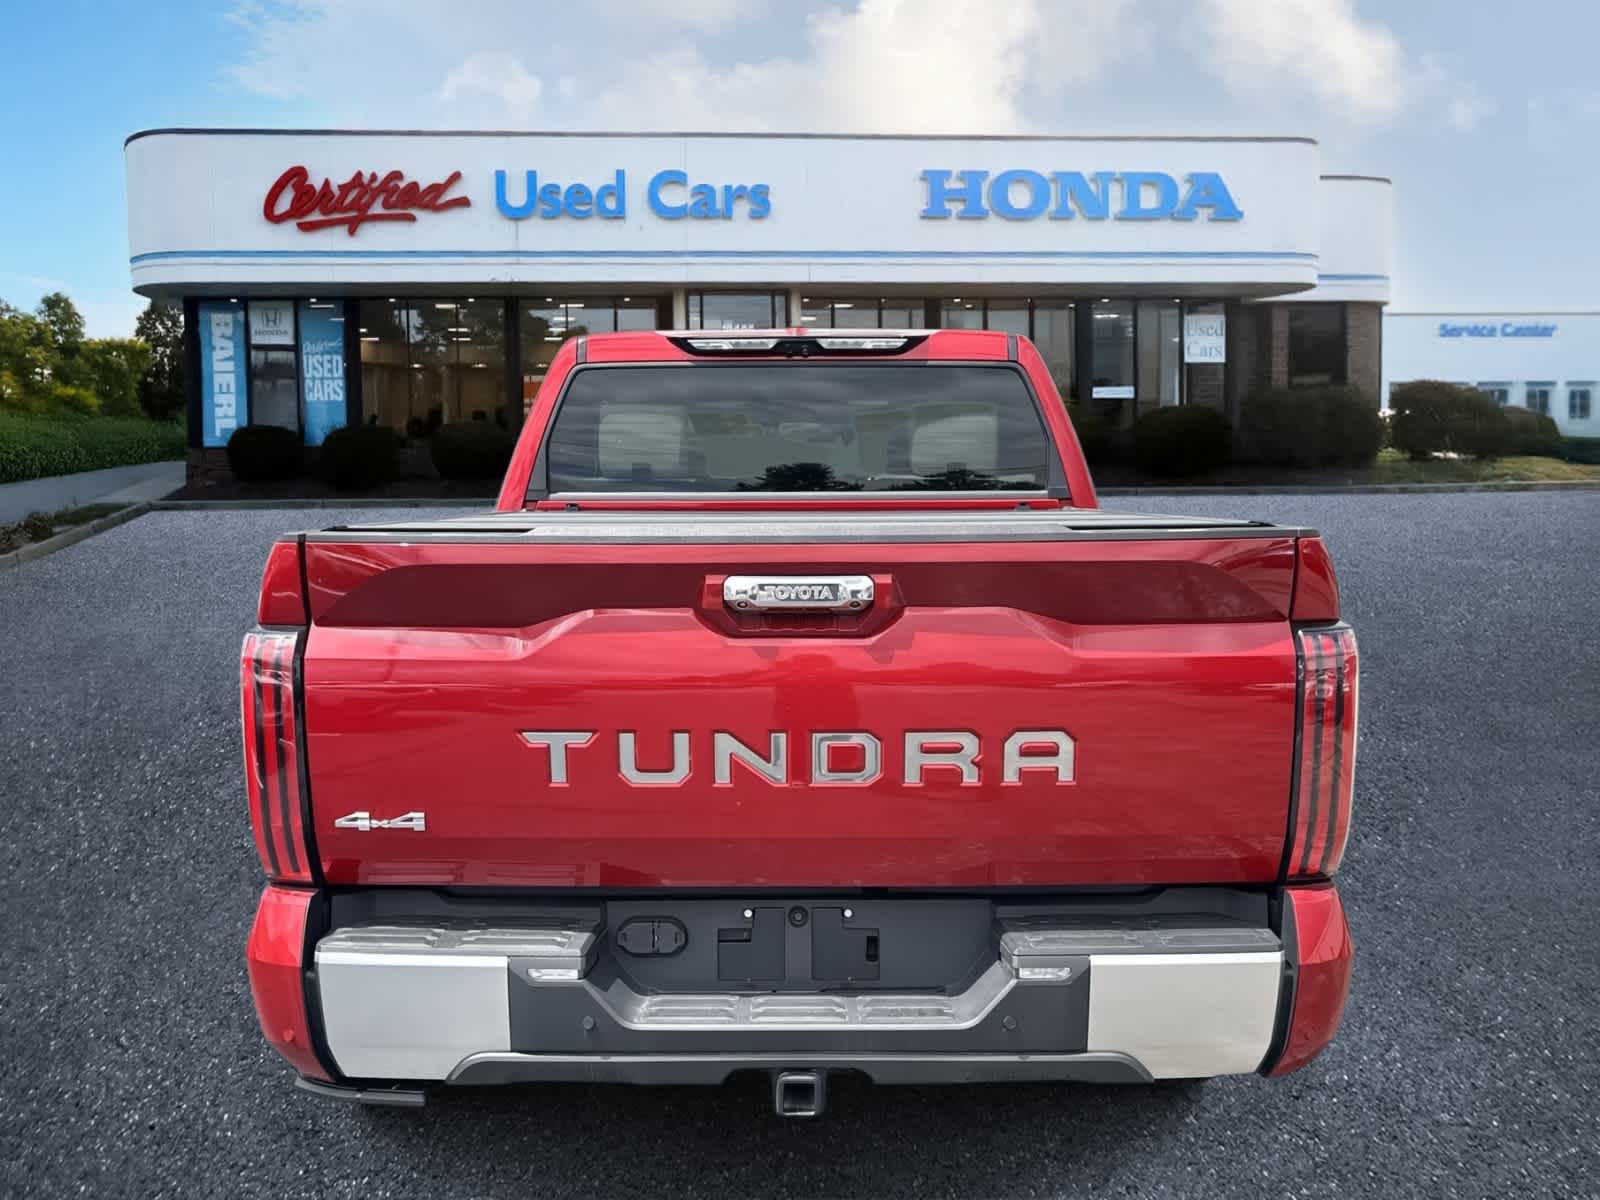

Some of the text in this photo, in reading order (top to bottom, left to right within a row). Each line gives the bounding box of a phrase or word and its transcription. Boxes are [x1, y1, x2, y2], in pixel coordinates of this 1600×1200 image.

[263, 165, 771, 237] Certified Used Cars
[919, 169, 1245, 221] HONDA
[1186, 319, 1224, 337] Used
[1439, 323, 1557, 337] Service Center
[1186, 341, 1223, 358] Cars
[210, 312, 237, 437] BAIERL
[303, 354, 343, 378] USED
[305, 379, 344, 401] CARS
[764, 585, 833, 600] TOYOTA
[519, 730, 1077, 788] TUNDRA
